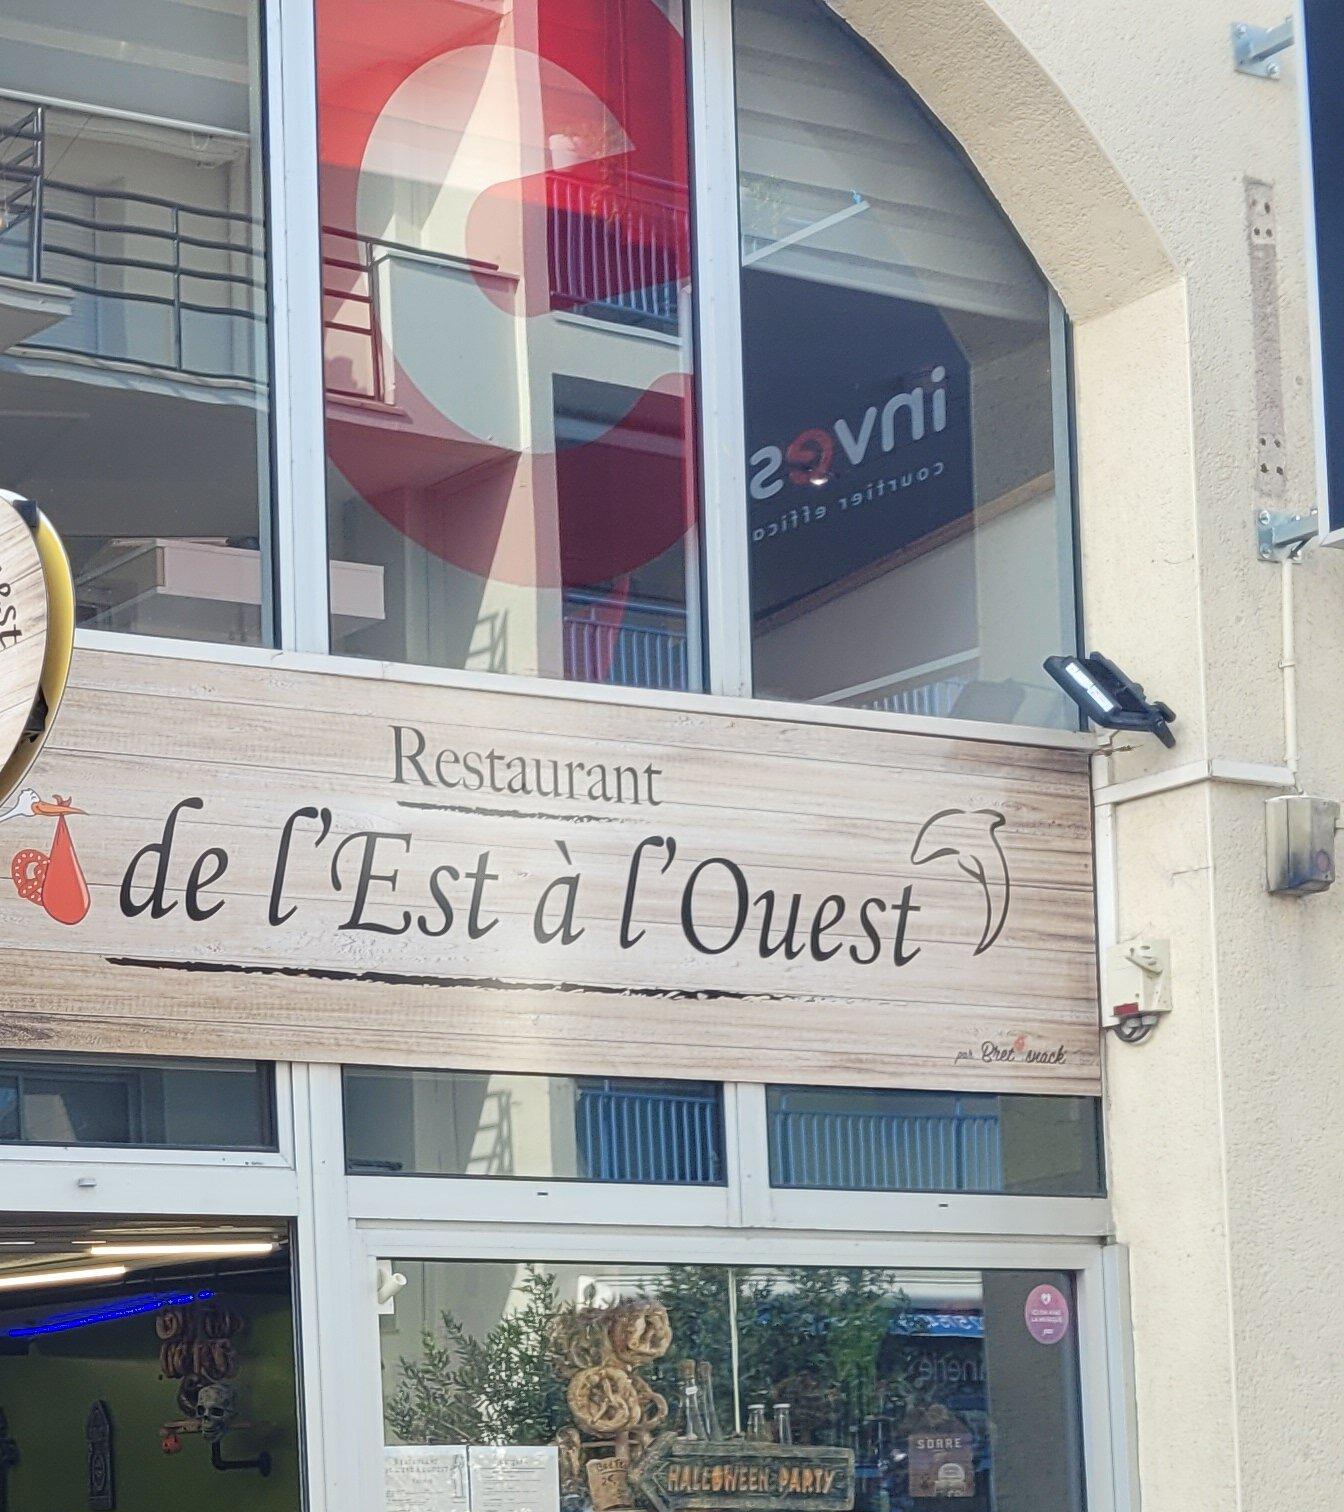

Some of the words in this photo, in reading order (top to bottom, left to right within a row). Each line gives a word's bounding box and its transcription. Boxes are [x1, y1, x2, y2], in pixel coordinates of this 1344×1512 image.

[390, 725, 663, 806] Restaurant
[119, 797, 227, 922] de
[533, 839, 584, 944] à
[667, 1463, 771, 1492] HALLOWEEN
[778, 1466, 836, 1493] PARTY
